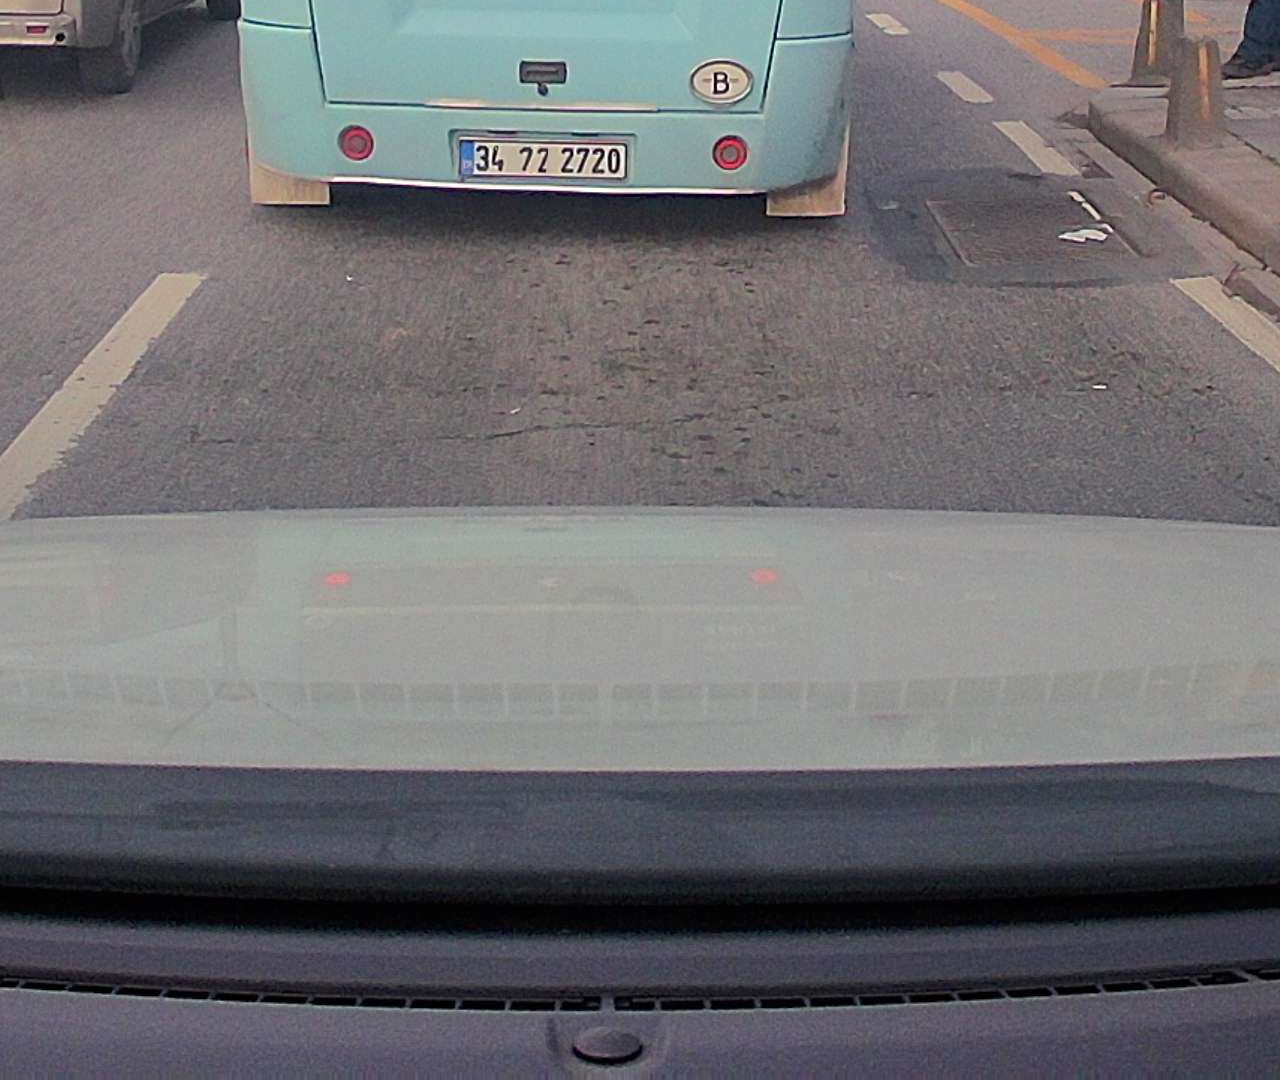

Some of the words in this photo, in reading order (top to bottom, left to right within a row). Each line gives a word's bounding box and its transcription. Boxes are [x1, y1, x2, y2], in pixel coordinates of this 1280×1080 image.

[713, 71, 730, 95] B
[476, 145, 504, 172] 34
[561, 148, 621, 174] 2720
